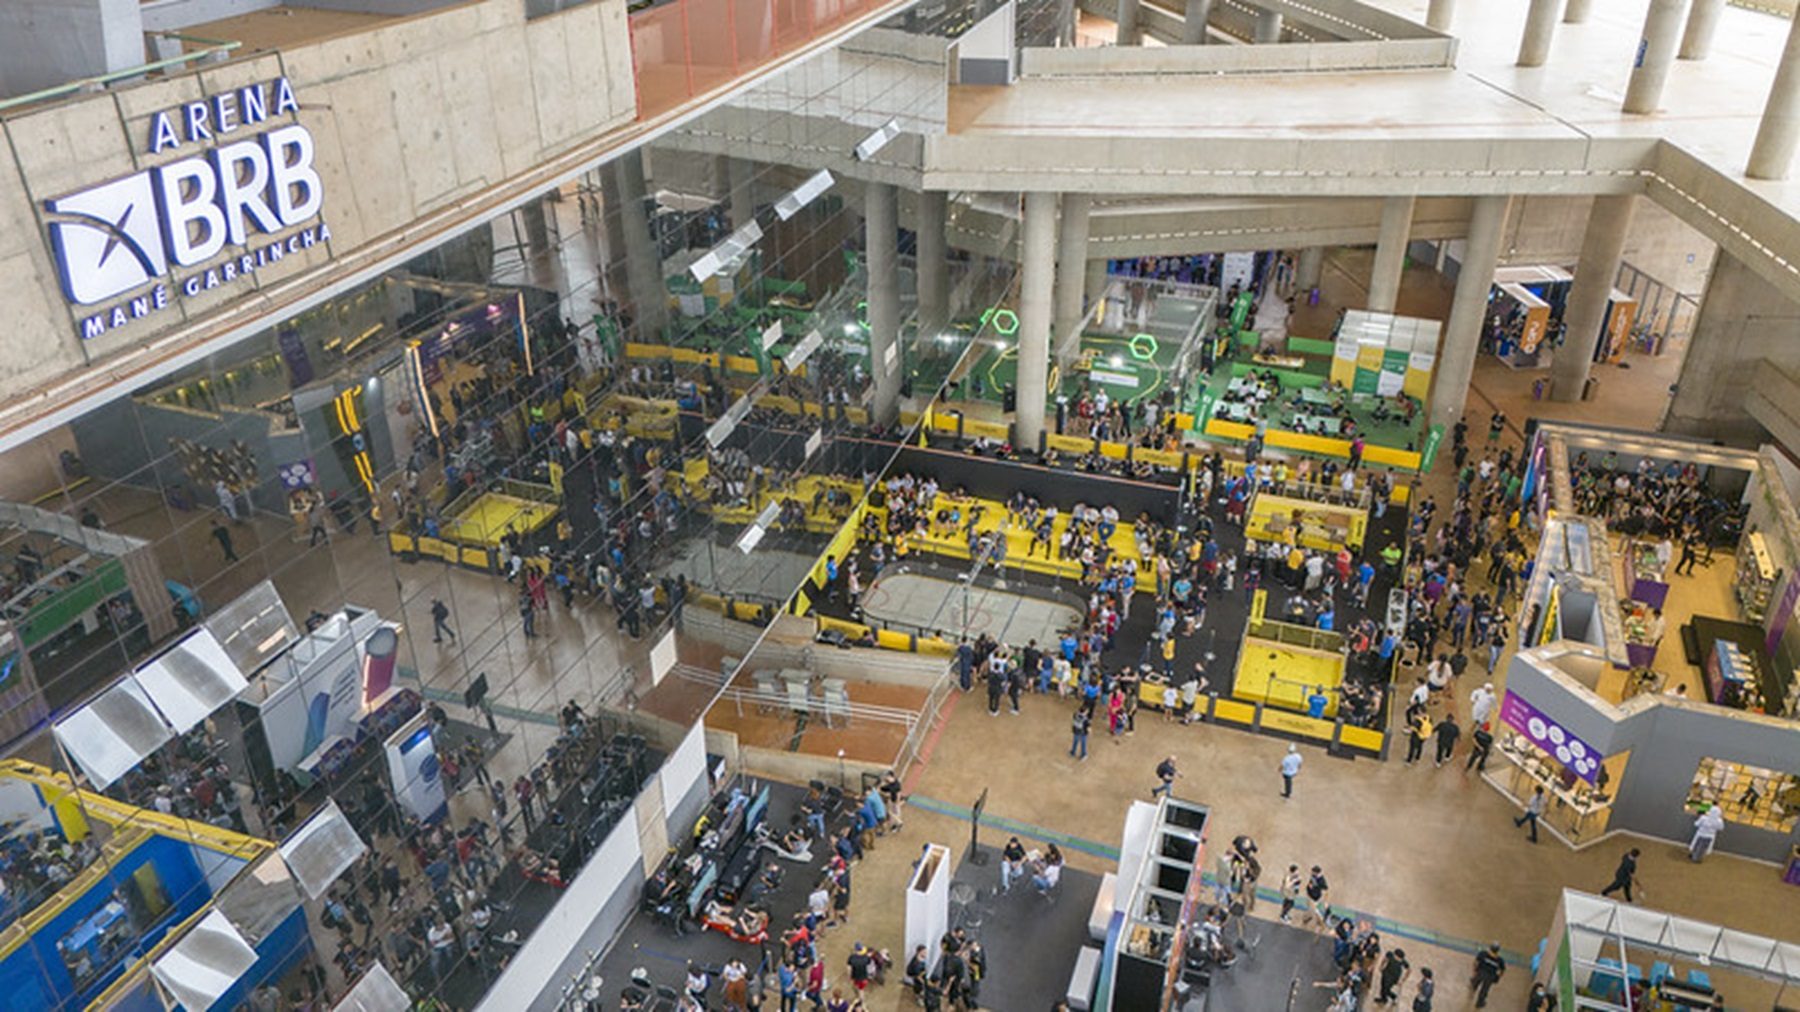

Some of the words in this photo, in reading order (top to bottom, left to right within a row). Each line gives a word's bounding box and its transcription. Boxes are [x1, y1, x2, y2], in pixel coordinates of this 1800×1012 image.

[150, 77, 300, 153] ARENA
[156, 124, 324, 267] BRB
[81, 285, 169, 340] MANÉ
[184, 222, 332, 296] GARRINCHA
